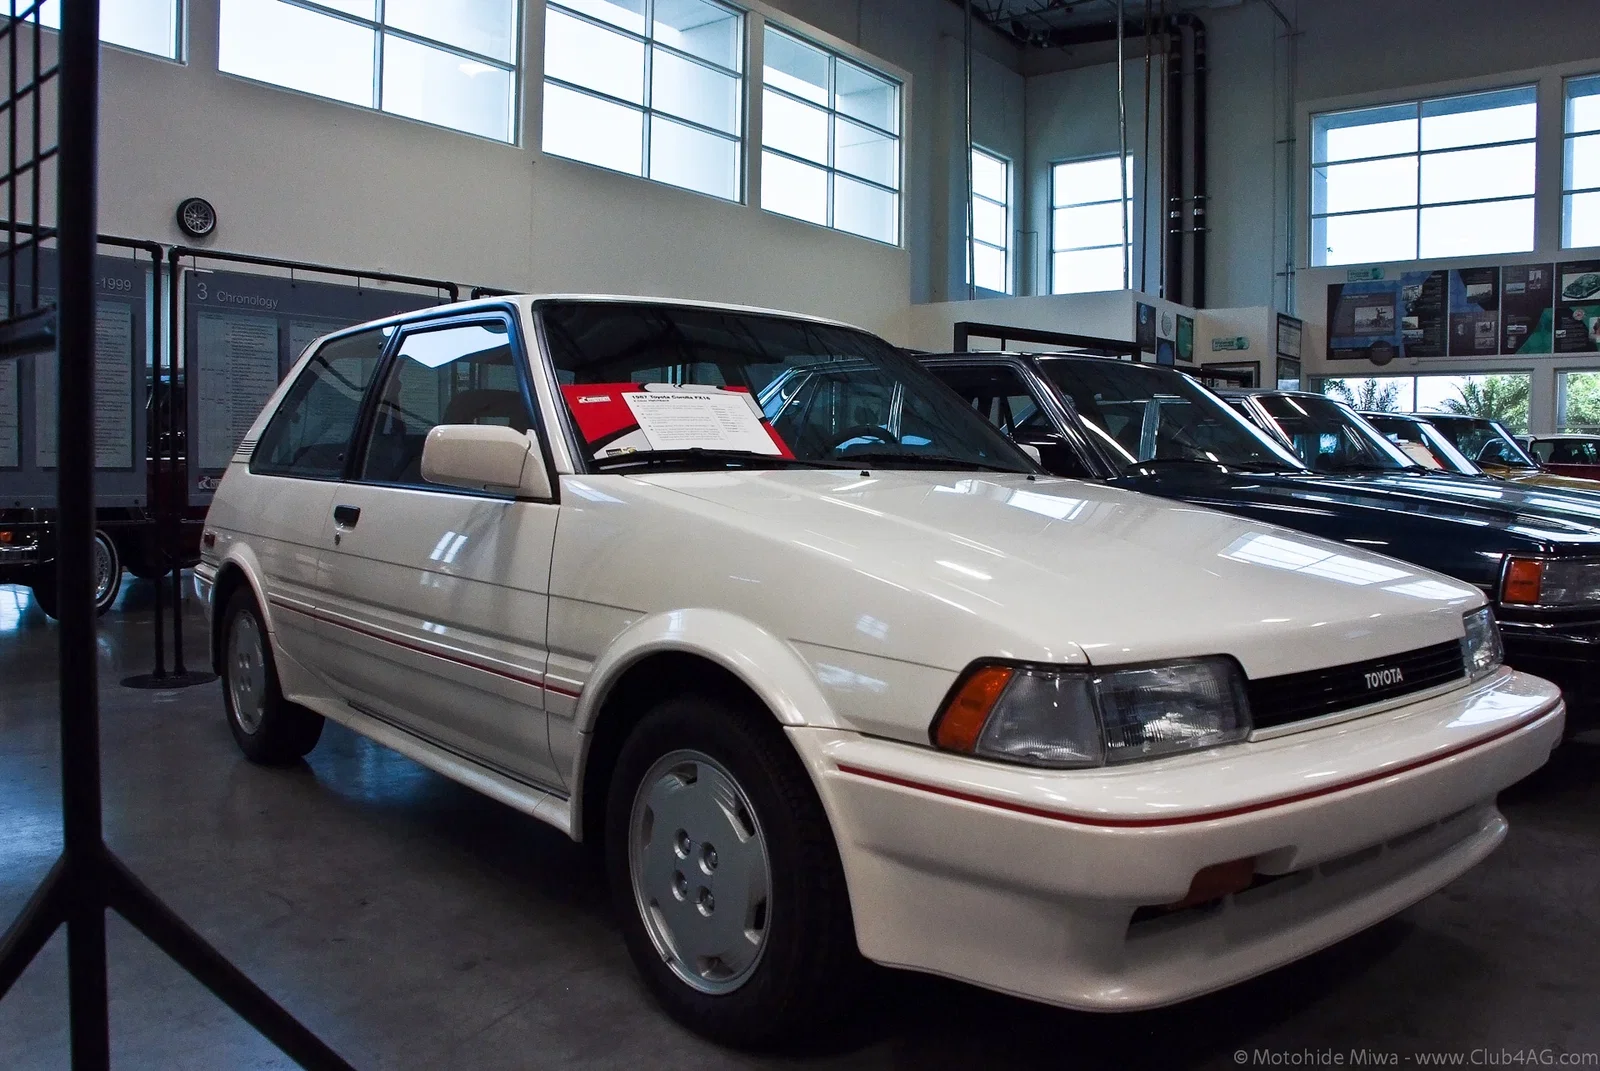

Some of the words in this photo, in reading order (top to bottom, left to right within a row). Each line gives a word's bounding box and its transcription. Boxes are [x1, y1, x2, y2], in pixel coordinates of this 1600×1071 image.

[196, 282, 209, 300] 3
[216, 290, 279, 310] Chronology
[1364, 667, 1404, 689] TOYOTA
